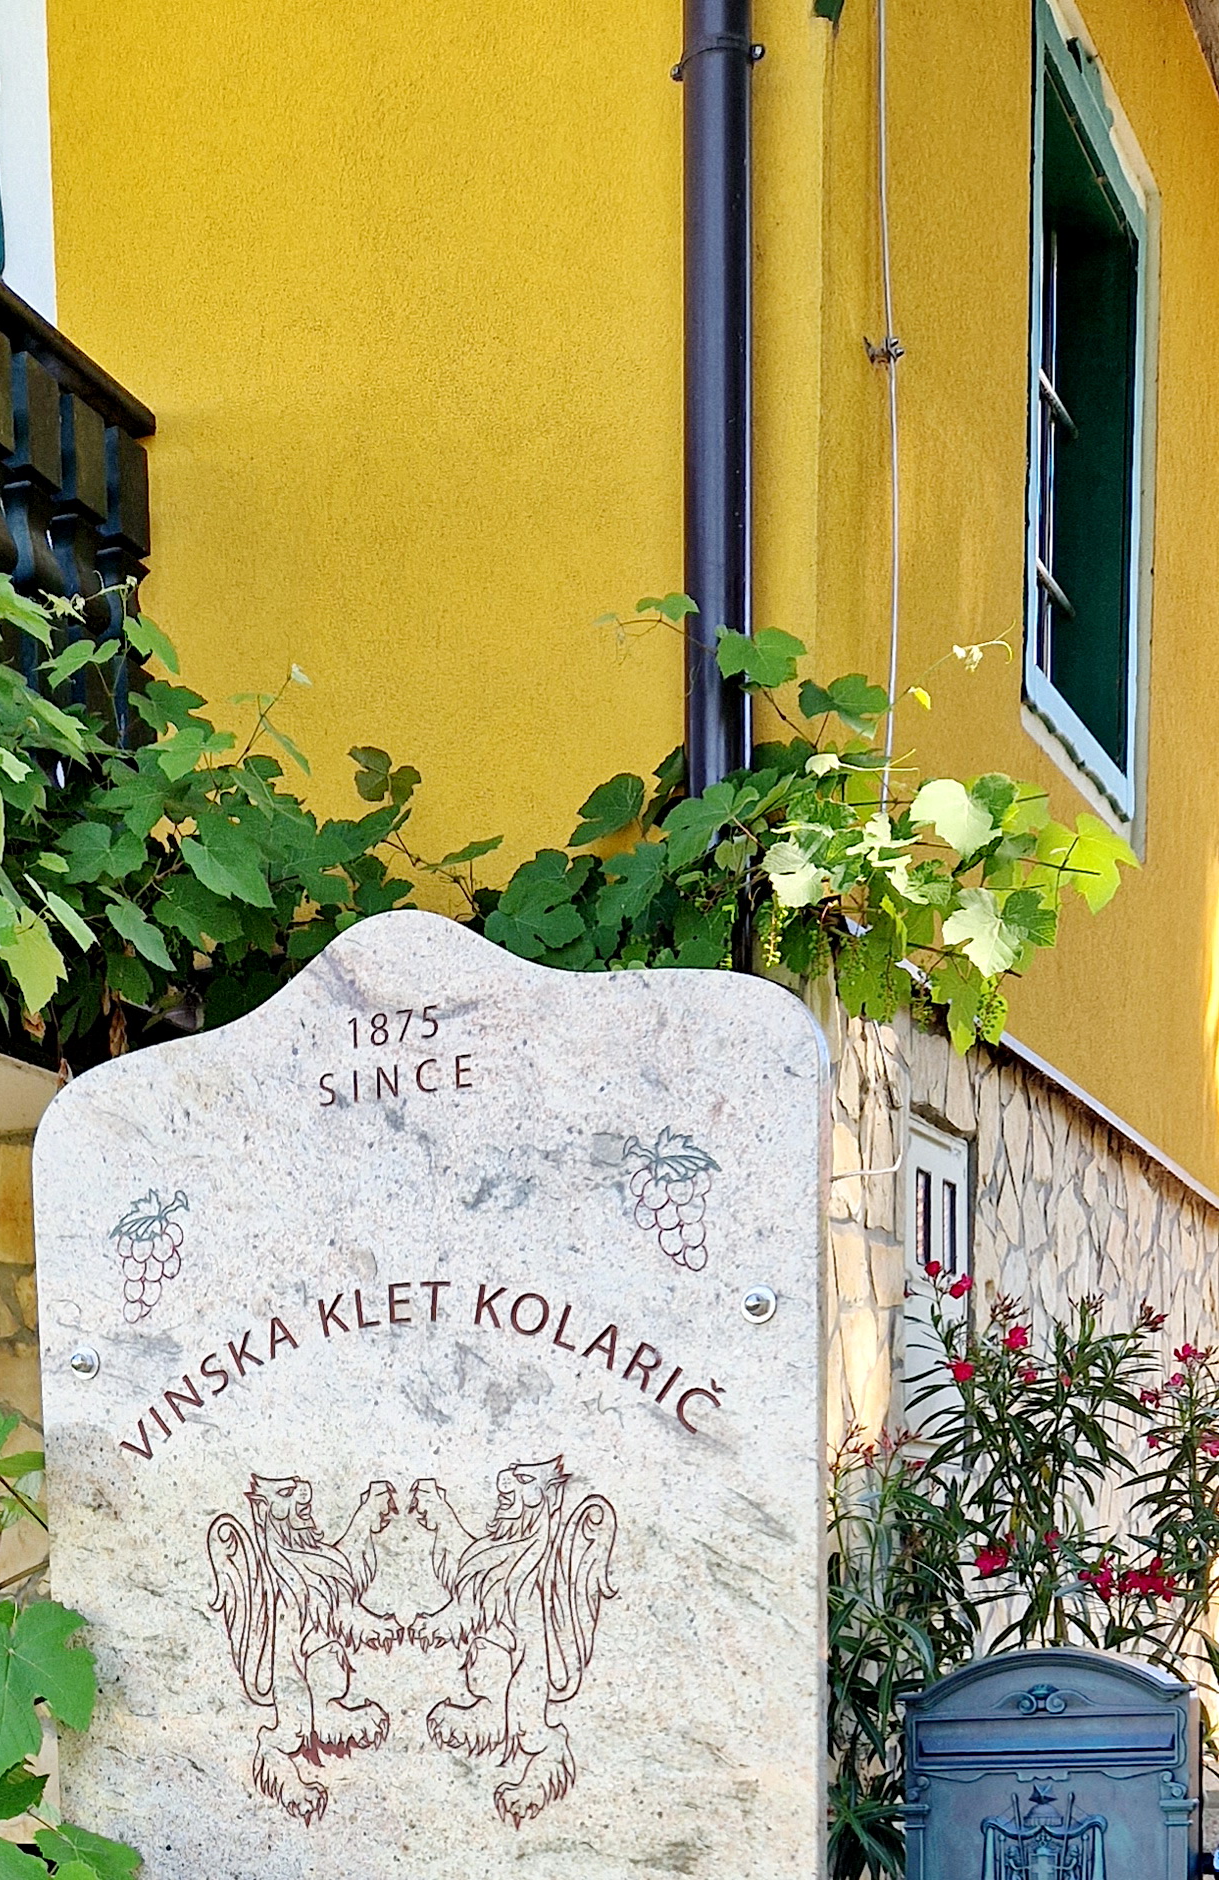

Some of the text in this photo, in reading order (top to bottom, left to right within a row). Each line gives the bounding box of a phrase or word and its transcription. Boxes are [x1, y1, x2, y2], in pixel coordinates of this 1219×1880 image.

[347, 1004, 439, 1050] 1875
[318, 1053, 473, 1107] SINCE
[118, 1281, 727, 1461] VINSKA KLET KOLARIČ
